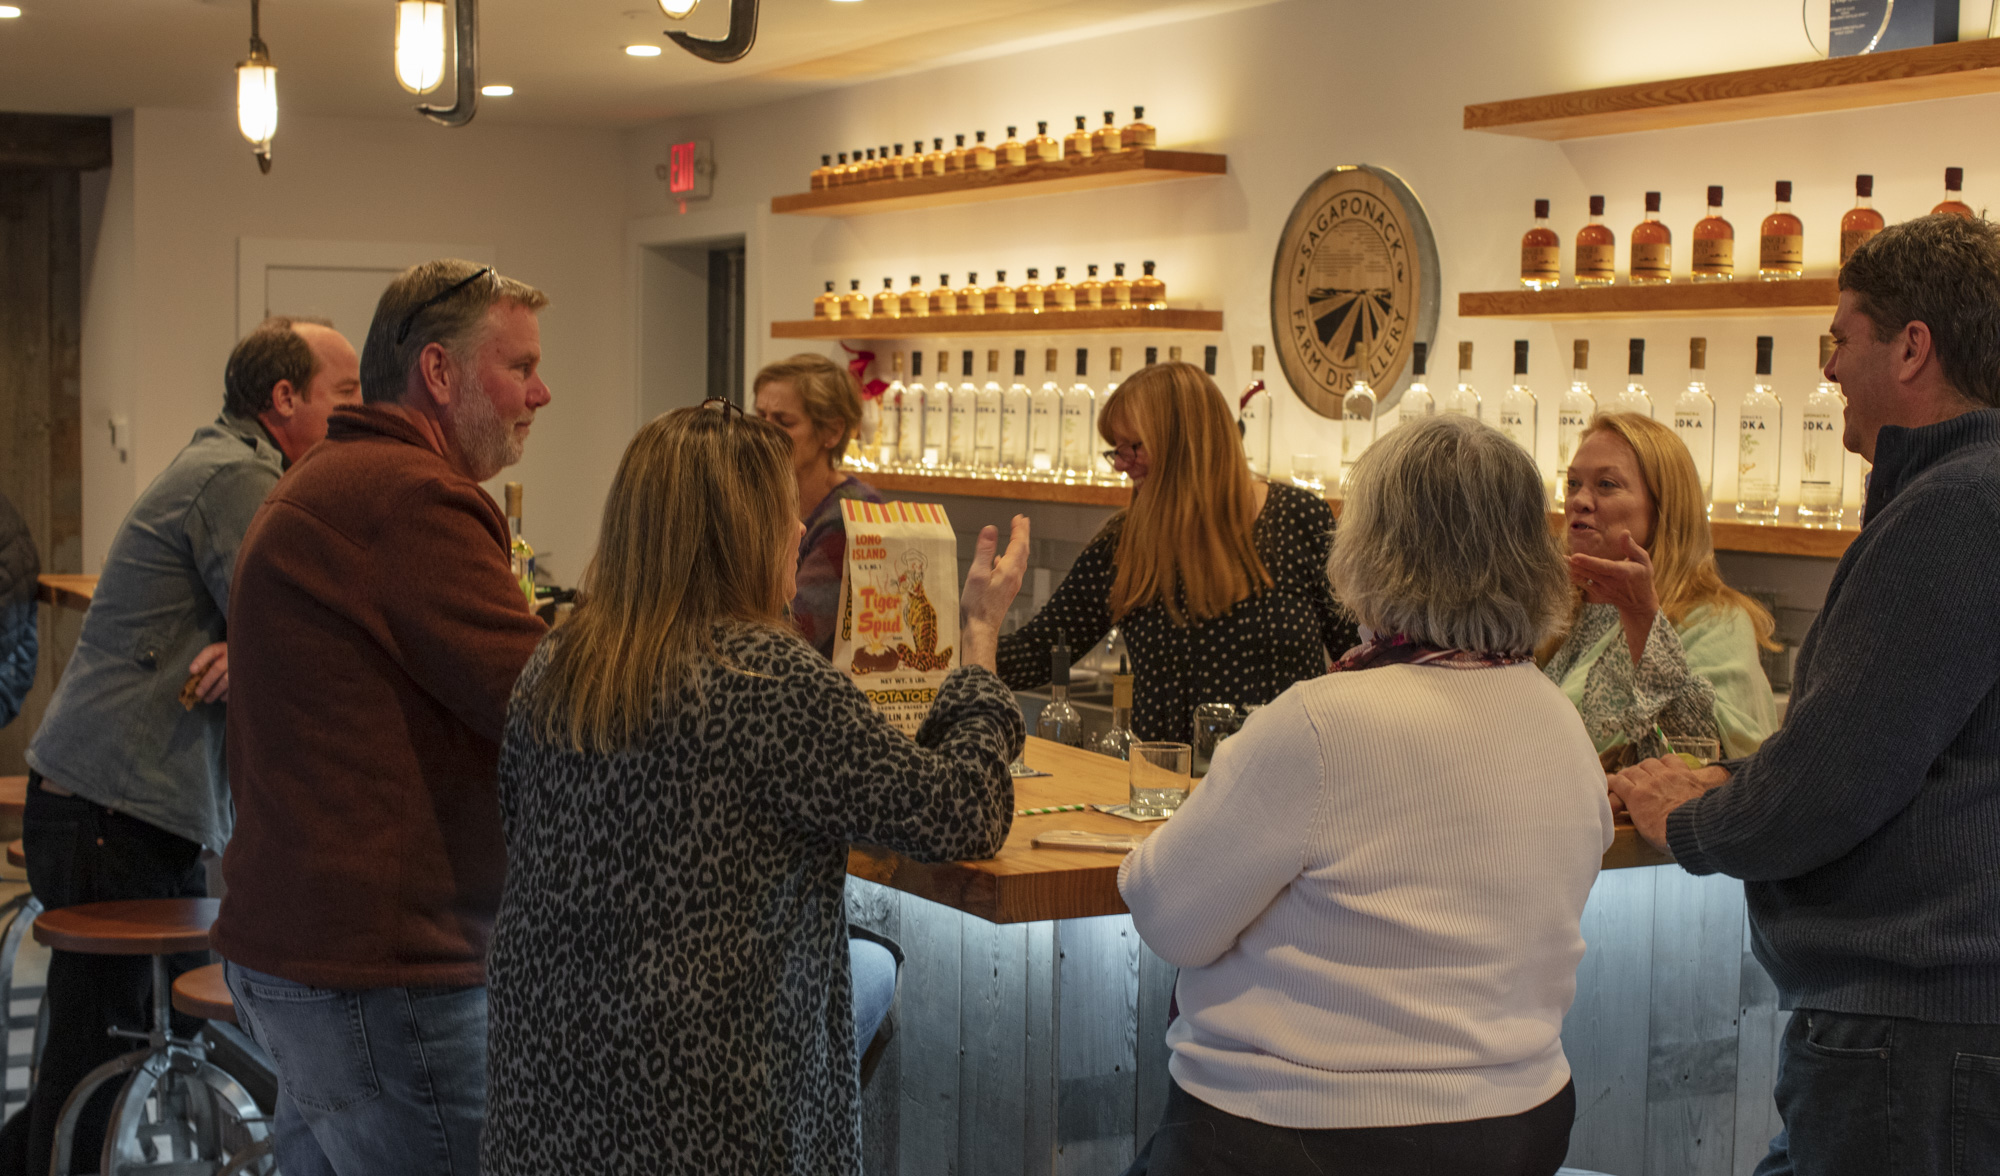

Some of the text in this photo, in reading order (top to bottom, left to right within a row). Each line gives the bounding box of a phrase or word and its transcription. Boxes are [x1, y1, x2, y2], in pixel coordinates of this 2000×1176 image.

[1301, 196, 1403, 259] SAGAPONACK
[1293, 307, 1406, 390] FARM DISLLERY
[856, 534, 882, 546] LONG
[852, 548, 887, 560] ISLAND
[859, 587, 902, 615] Tiger
[857, 611, 902, 639] Spud
[865, 688, 938, 705] POTATOES
[905, 712, 911, 720] &
